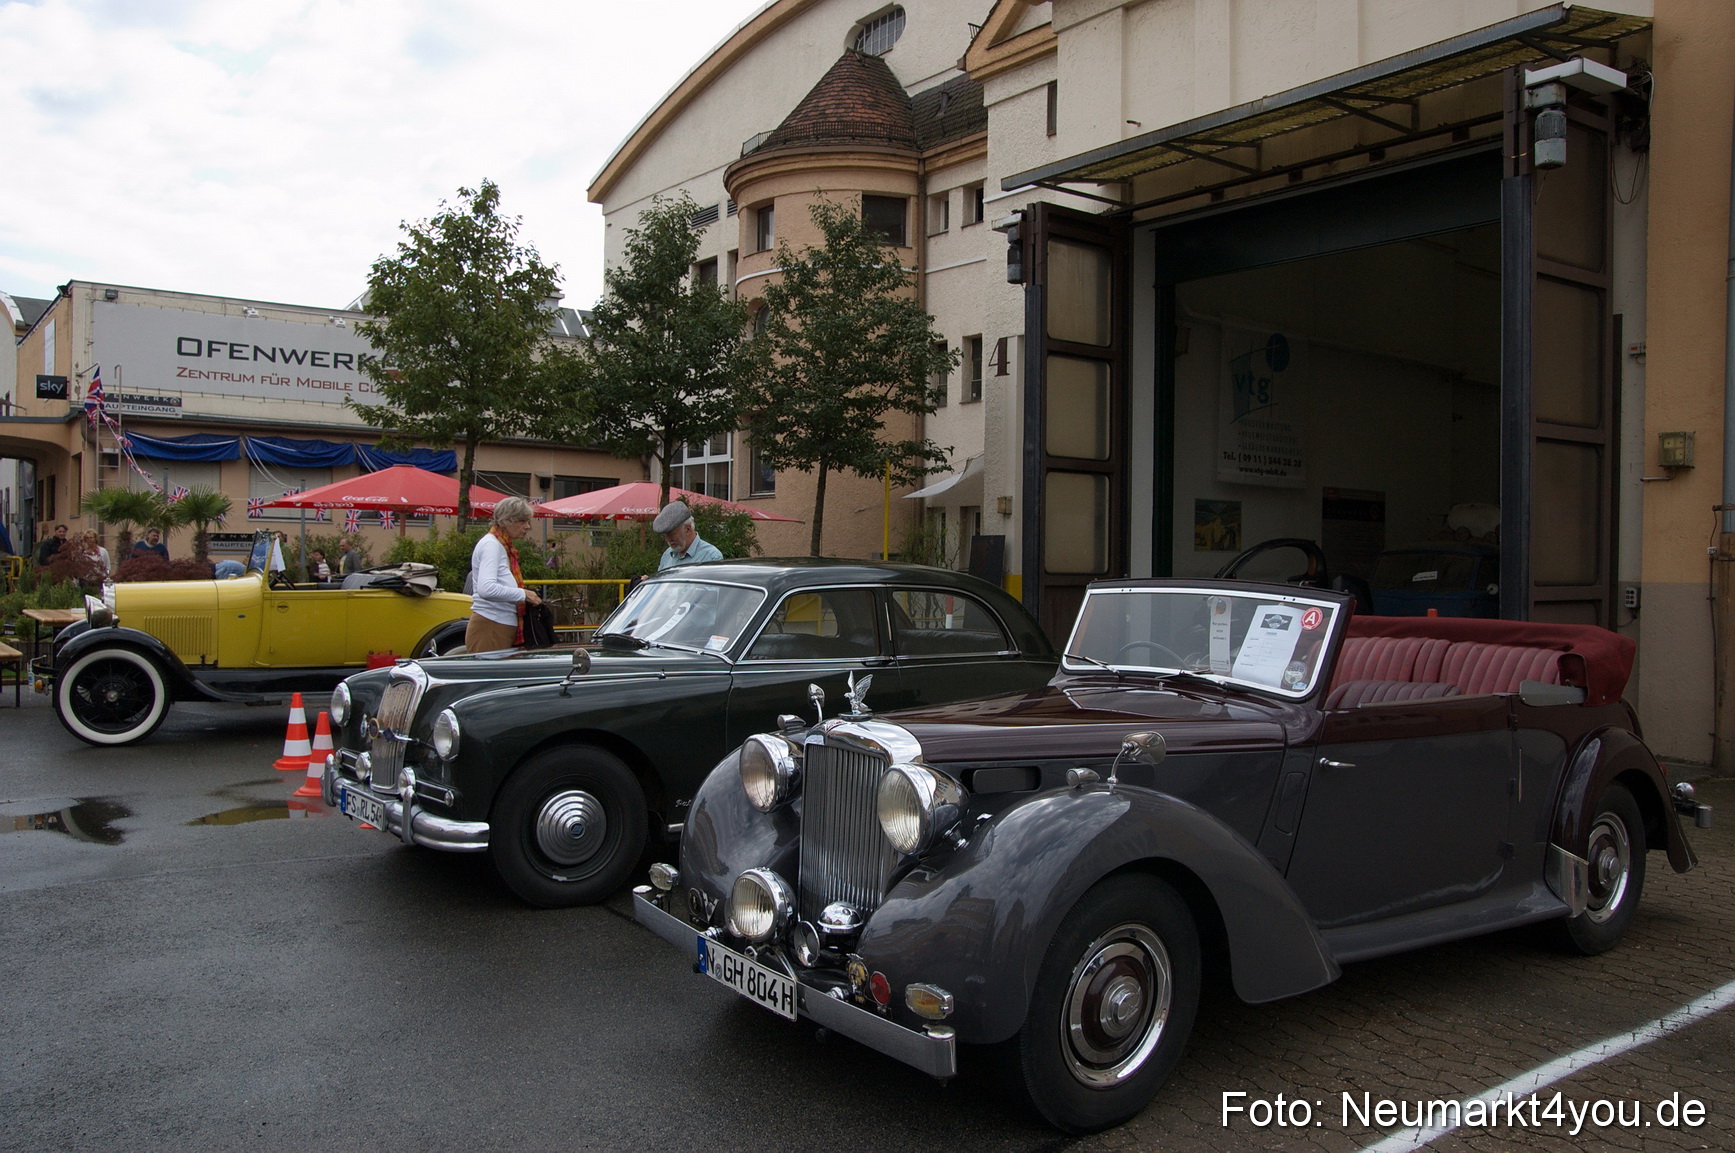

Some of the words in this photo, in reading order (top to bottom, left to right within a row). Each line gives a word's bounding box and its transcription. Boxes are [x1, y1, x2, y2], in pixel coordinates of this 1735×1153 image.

[176, 336, 377, 372] OFENWERK
[988, 337, 1010, 377] 4
[39, 380, 64, 394] sky
[1234, 371, 1271, 404] vtg
[104, 393, 169, 403] FENWERK
[105, 403, 176, 413] AUPTEINGANG
[1223, 451, 1236, 460] Tel.
[1304, 611, 1316, 625] A
[346, 792, 357, 813] FS
[361, 798, 370, 821] RL
[706, 945, 715, 974] N
[724, 954, 744, 989] GH
